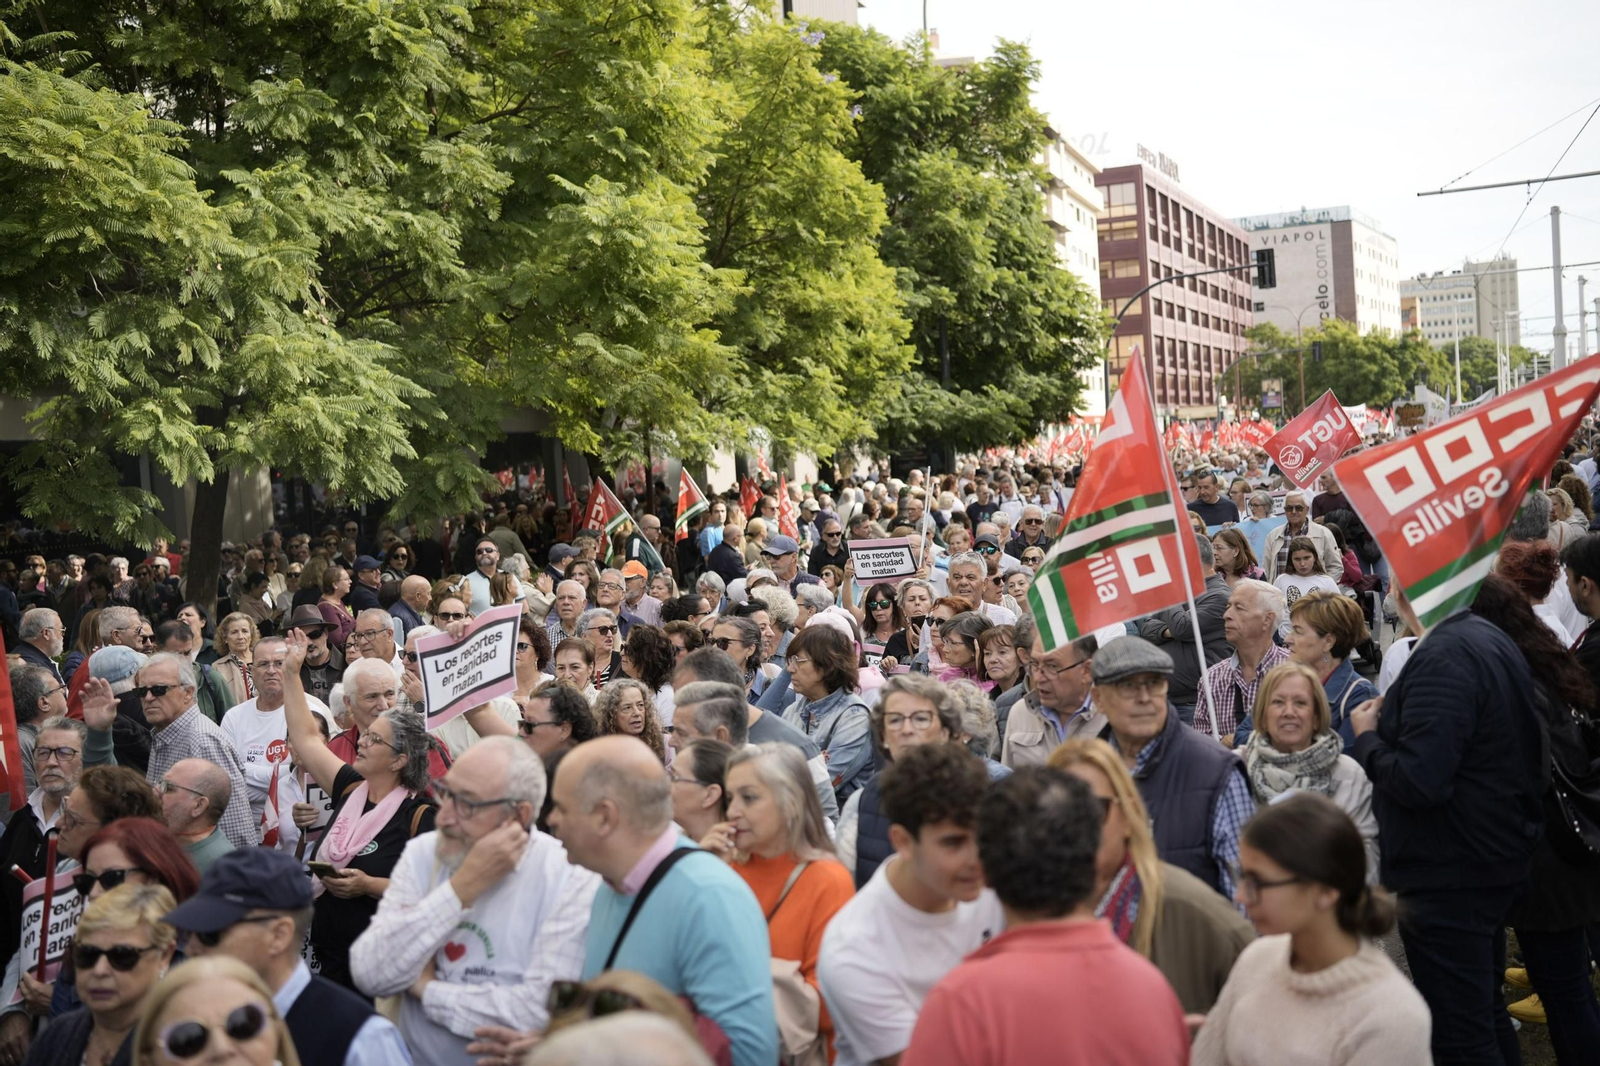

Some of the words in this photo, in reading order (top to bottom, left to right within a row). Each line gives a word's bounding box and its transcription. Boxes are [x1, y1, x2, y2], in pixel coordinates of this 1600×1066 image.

[1261, 230, 1326, 245] VIAPOL
[1315, 243, 1330, 326] celo.com
[856, 552, 871, 560] Los
[872, 551, 905, 559] recortes
[872, 558, 904, 567] sanidad
[872, 567, 897, 575] matan
[434, 655, 458, 673] Los
[460, 631, 503, 662] recortes
[442, 672, 455, 687] en
[456, 645, 498, 679] sanidad
[868, 656, 880, 665] Lo
[451, 670, 483, 696] matan
[268, 744, 286, 755] UGT
[22, 909, 41, 931] Los
[24, 931, 36, 948] en
